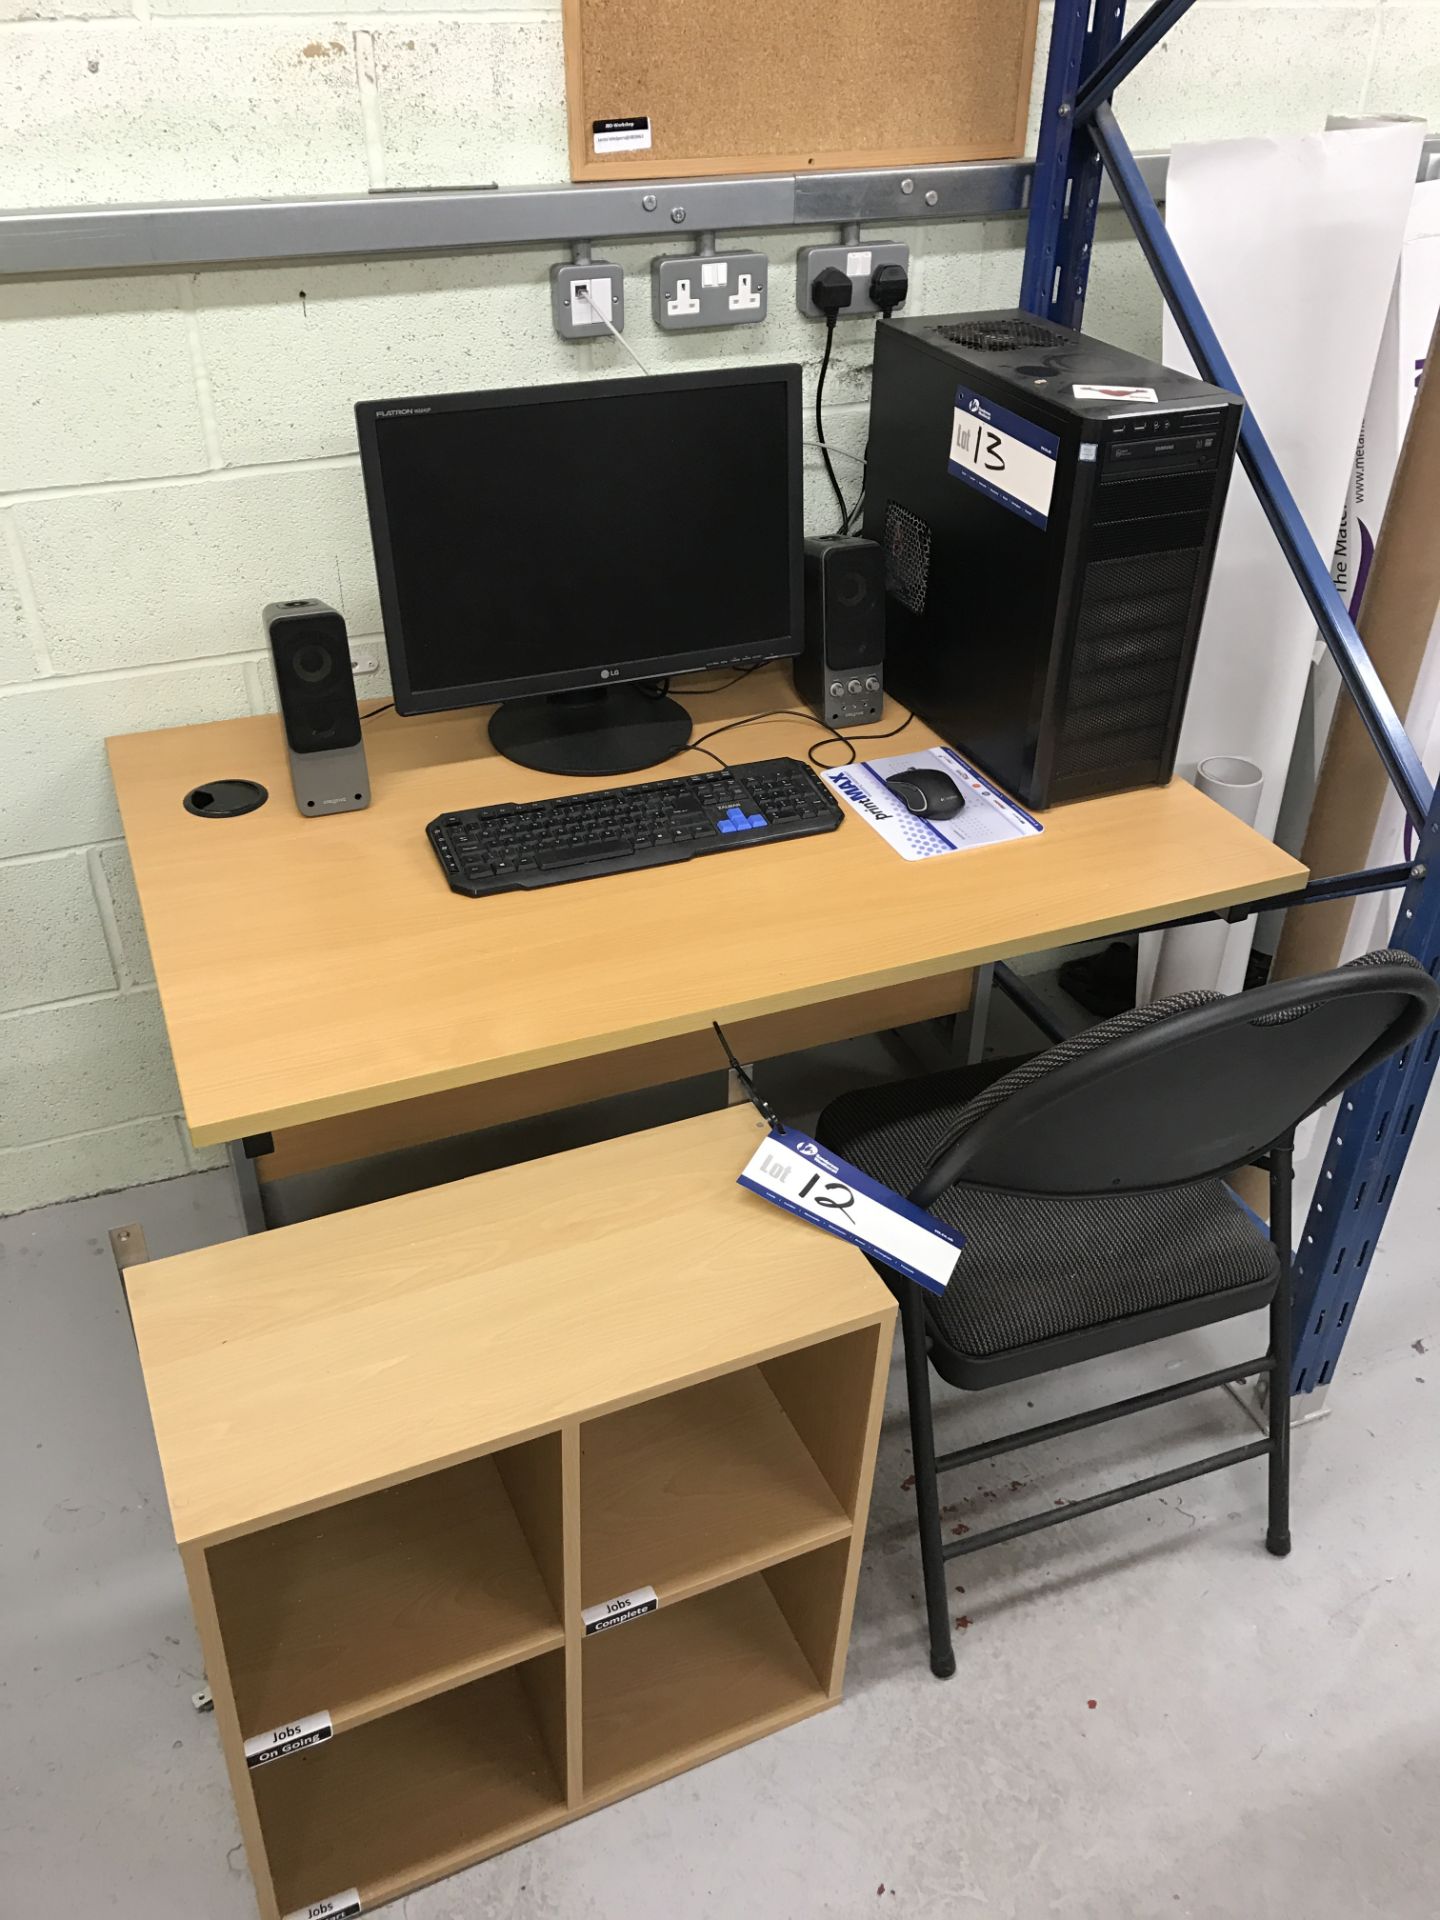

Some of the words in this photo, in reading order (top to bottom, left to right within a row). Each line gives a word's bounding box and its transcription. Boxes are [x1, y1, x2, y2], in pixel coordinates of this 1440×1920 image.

[376, 408, 413, 417] FLATRON
[957, 424, 971, 452] Lot
[974, 426, 1005, 470] 13
[828, 772, 893, 820] printMAX
[760, 1154, 792, 1183] Lot
[798, 1173, 855, 1225] 12
[595, 1606, 648, 1631] Complete
[606, 1598, 631, 1613] Jobs
[259, 1751, 278, 1761] On
[282, 1734, 321, 1752] Going
[272, 1725, 302, 1743] Jobs
[308, 1902, 333, 1919] Jobs
